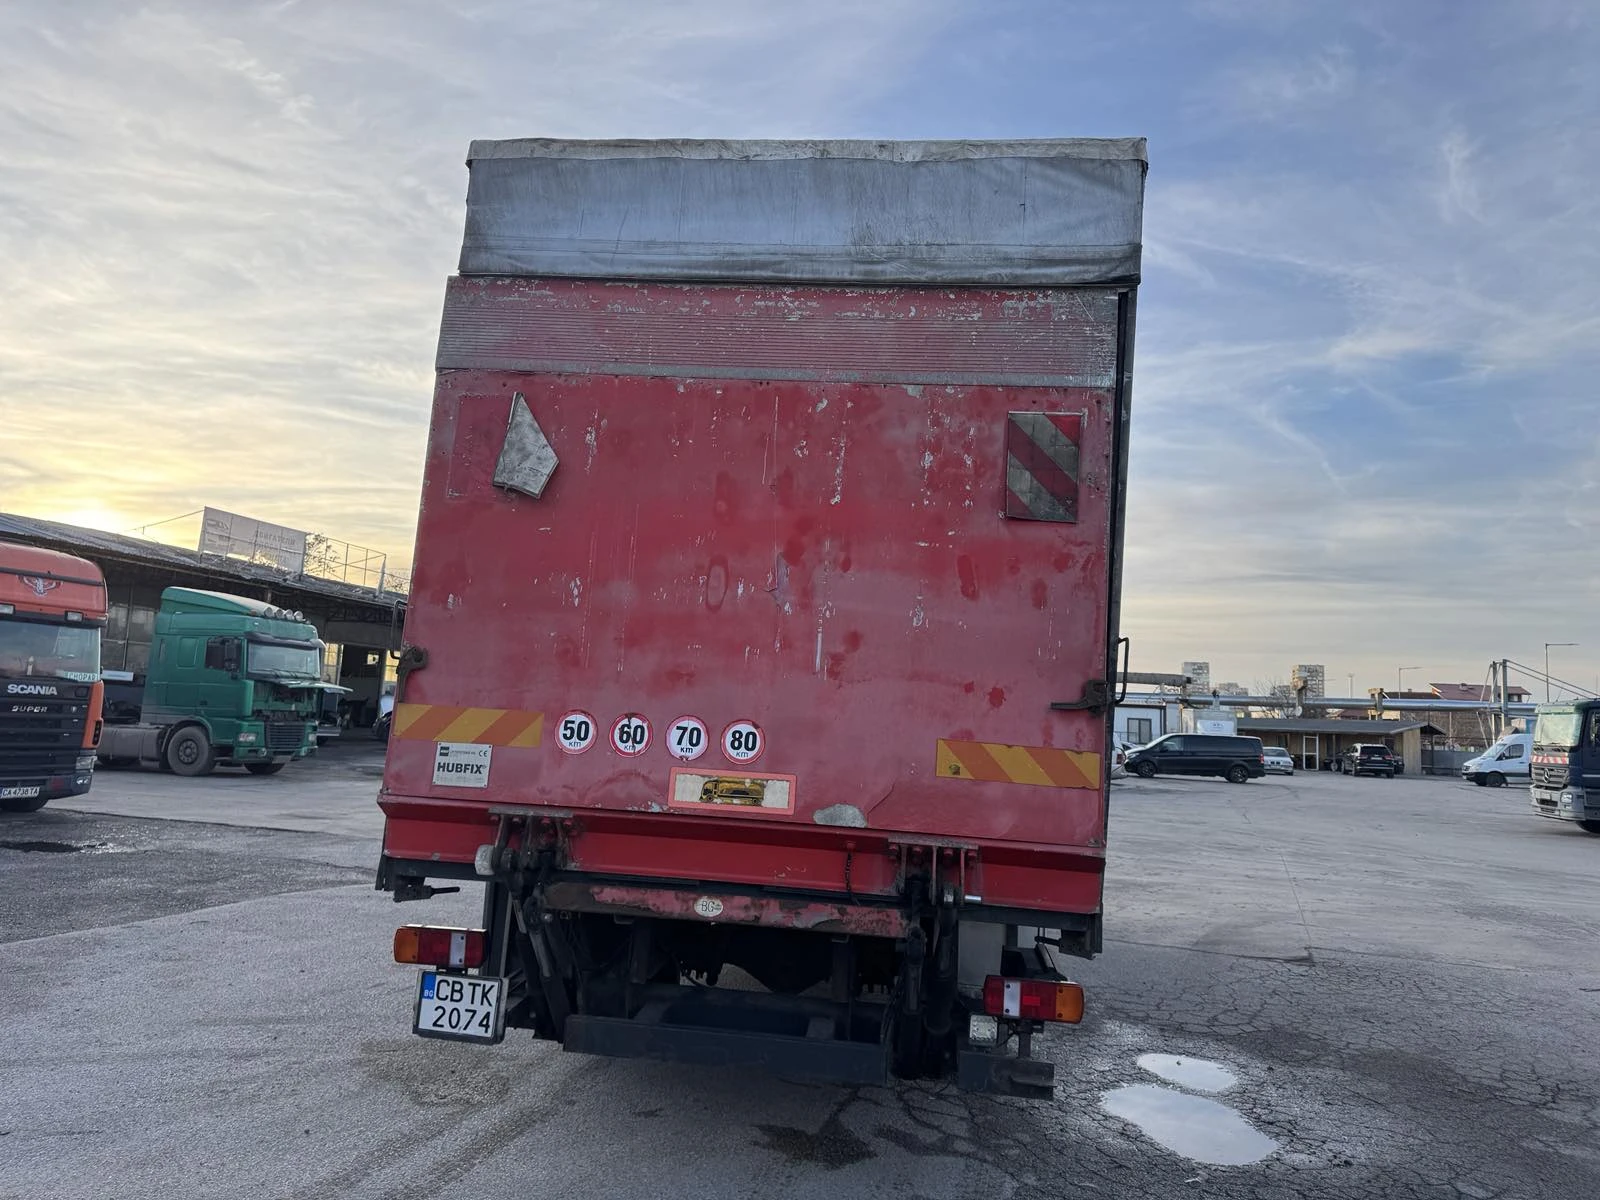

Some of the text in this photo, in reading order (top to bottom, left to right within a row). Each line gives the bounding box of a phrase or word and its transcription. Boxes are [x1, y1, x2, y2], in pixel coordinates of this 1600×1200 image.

[8, 684, 58, 695] SCANIA
[11, 704, 48, 713] SUPER
[562, 719, 590, 742] 50
[618, 724, 645, 745] 60
[675, 725, 702, 748] 70
[731, 729, 758, 752] 80
[423, 988, 434, 998] BG
[432, 1004, 491, 1034] 2074
